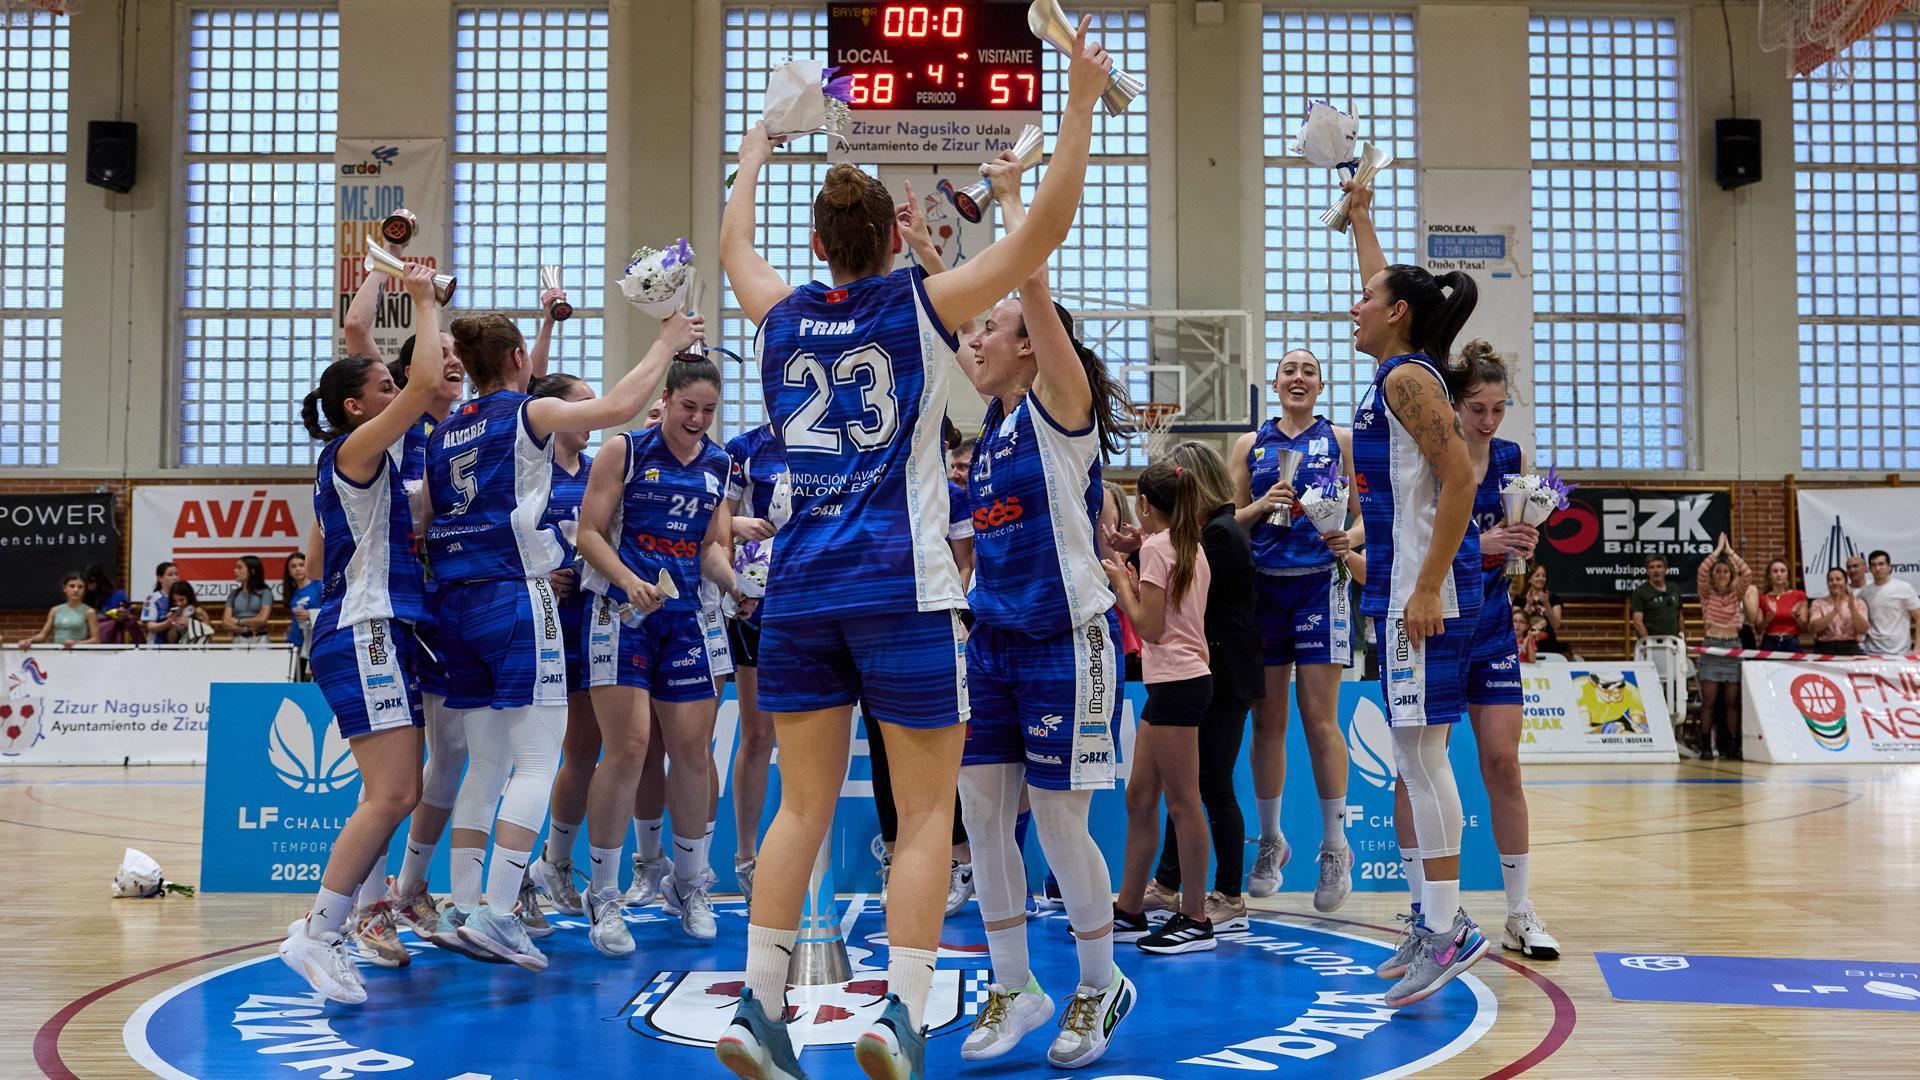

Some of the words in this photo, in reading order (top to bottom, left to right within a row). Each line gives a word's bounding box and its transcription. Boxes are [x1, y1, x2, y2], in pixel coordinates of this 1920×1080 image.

[884, 7, 963, 38] 00:0
[837, 49, 893, 64] LOCAL
[978, 48, 1033, 64] VISITANTE
[928, 65, 943, 84] 4
[850, 74, 894, 104] 68
[916, 91, 957, 105] PERIODO
[990, 74, 1035, 104] 57
[852, 122, 891, 135] Zizur
[896, 122, 970, 139] Nagusiko
[976, 124, 1010, 135] Udala
[835, 140, 918, 152] Ayuntamiento
[923, 140, 938, 151] de
[942, 138, 980, 151] Zizur
[985, 138, 1017, 151] May
[341, 160, 383, 175] ardoi
[341, 185, 404, 220] MEJOR
[1428, 224, 1478, 234] KIROLEAN,
[1428, 259, 1455, 269] Ondo
[799, 318, 856, 337] PRIM
[782, 341, 900, 455] 23
[443, 418, 488, 450] ÁLVAREZ
[446, 446, 479, 518] 5
[173, 490, 299, 538] AVÍA
[668, 494, 700, 519] 24
[973, 496, 1023, 530] sés
[1602, 494, 1715, 541] BZK
[0, 532, 107, 546] enchufable
[1604, 541, 1714, 554] Baizinka
[672, 656, 696, 669] ardoi
[1087, 625, 1106, 714] MegaCalzado
[53, 700, 97, 714] Zizur
[104, 699, 188, 718] Nagusiko
[1402, 694, 1419, 706] BZK
[51, 721, 146, 734] Ayuntamiento
[150, 721, 168, 732] de
[173, 717, 209, 731] Zizu
[1089, 752, 1109, 764] BZK
[239, 806, 279, 829] LF
[283, 817, 351, 829] CHALL
[1346, 805, 1364, 828] F
[272, 842, 333, 852] TEMPOR
[1214, 931, 1376, 977] MAYOR
